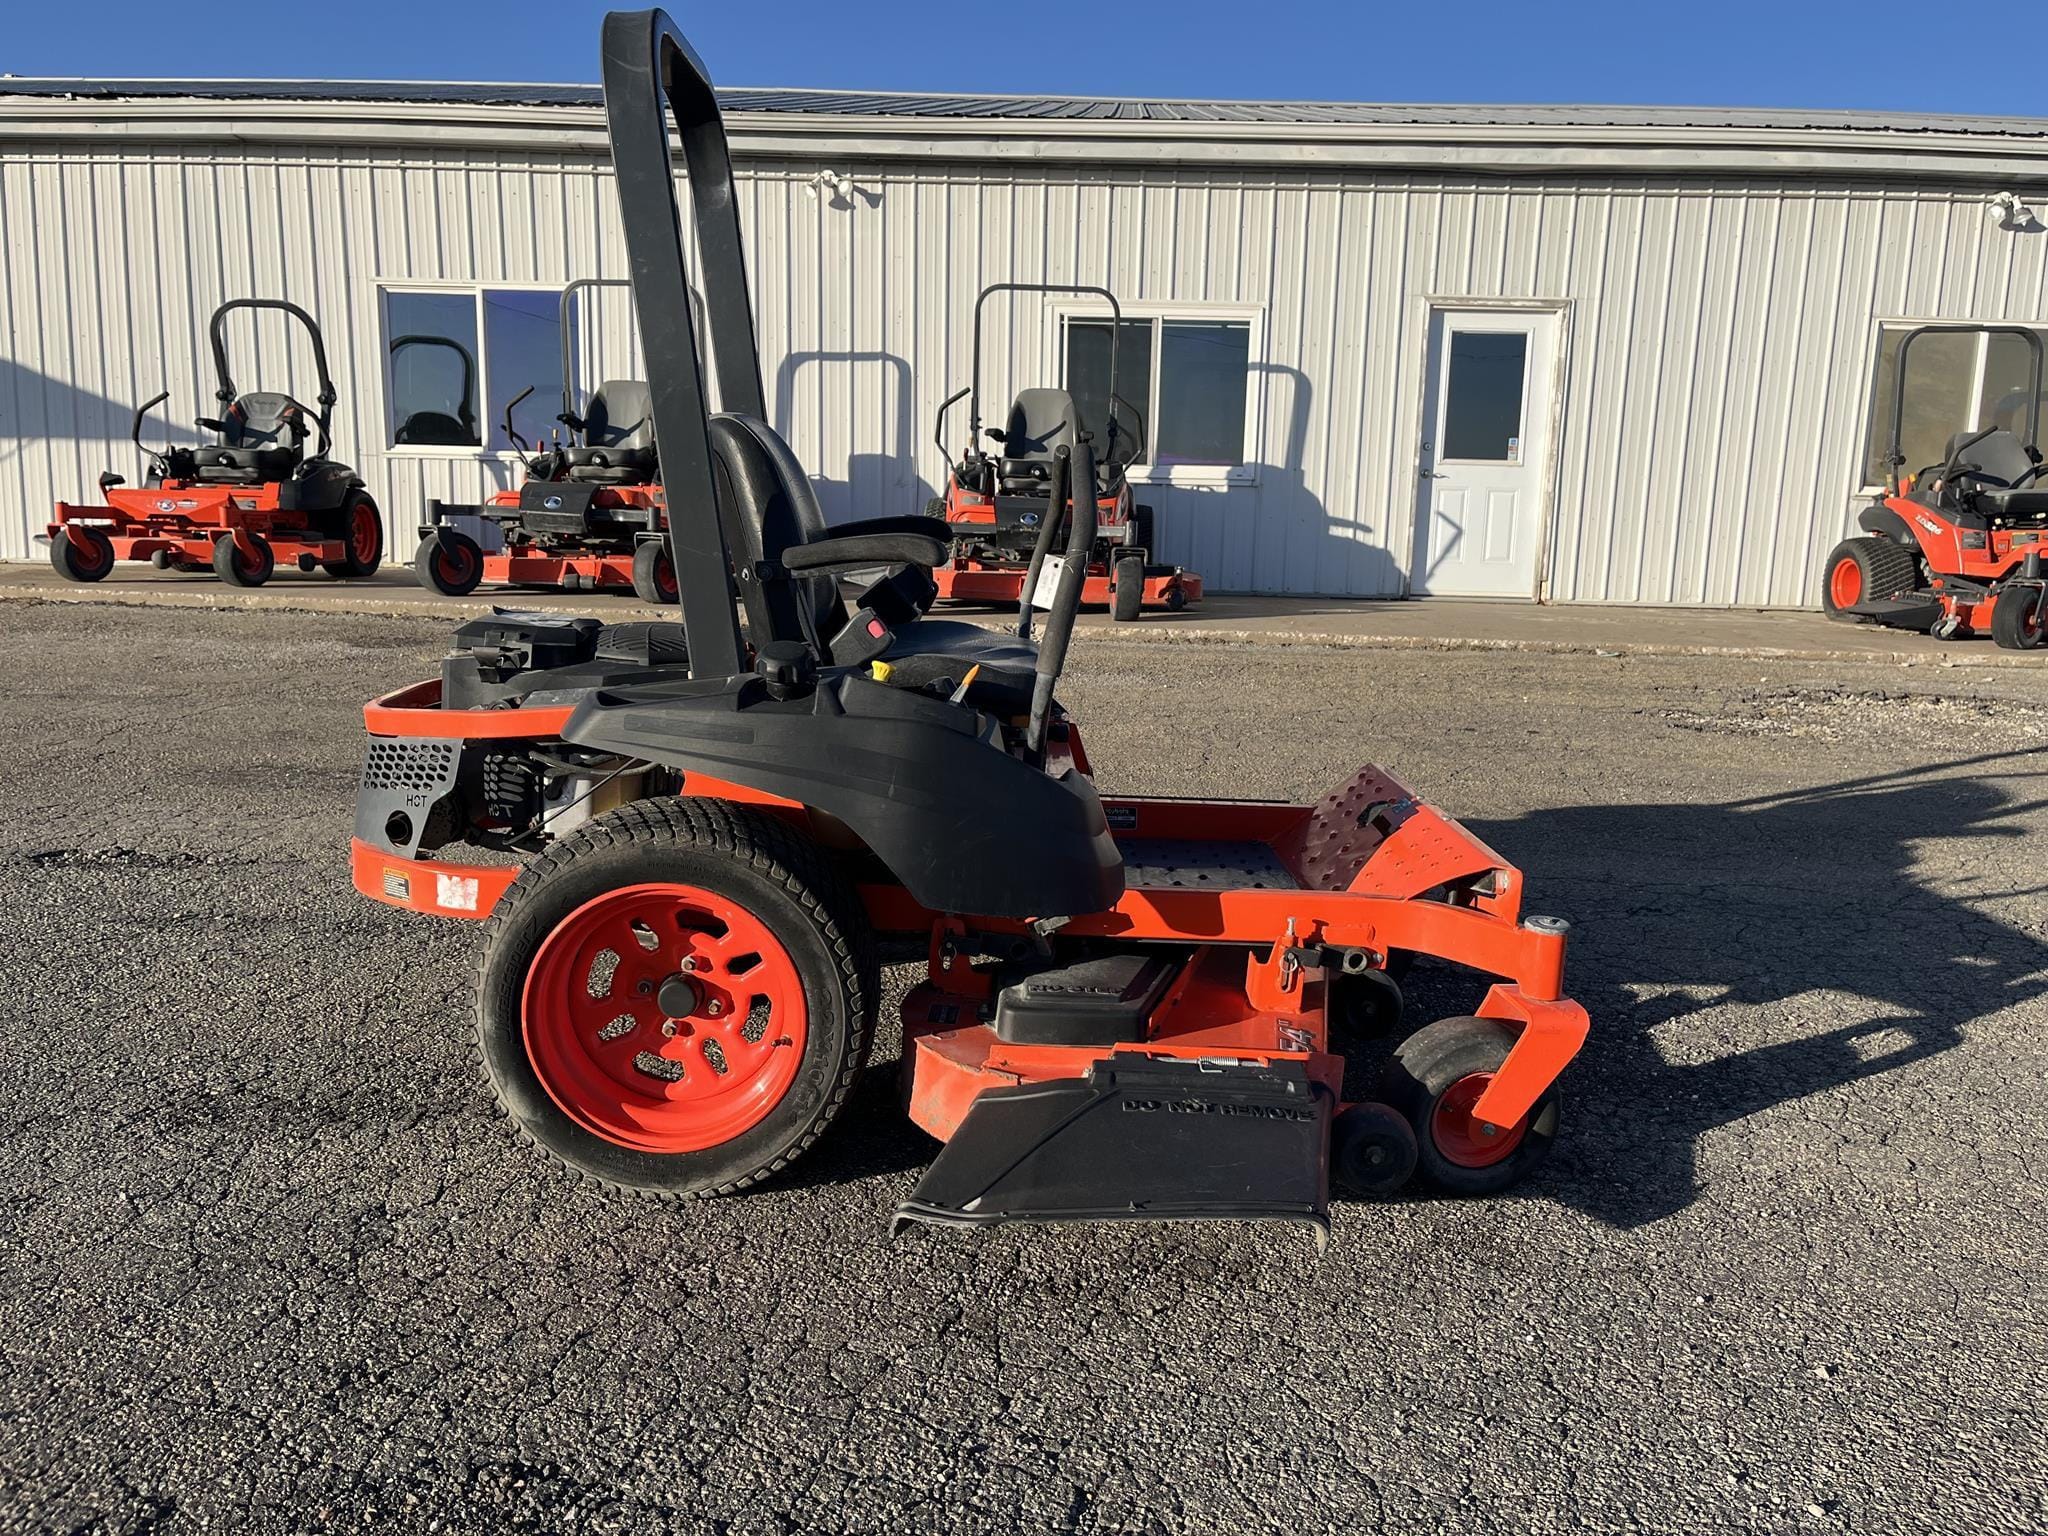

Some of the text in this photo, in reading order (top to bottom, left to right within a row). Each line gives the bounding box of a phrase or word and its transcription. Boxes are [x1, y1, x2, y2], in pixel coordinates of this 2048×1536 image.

[406, 794, 427, 808] HOT
[488, 803, 514, 818] HOT
[1121, 1099, 1319, 1121] DO NOT REMOVE
